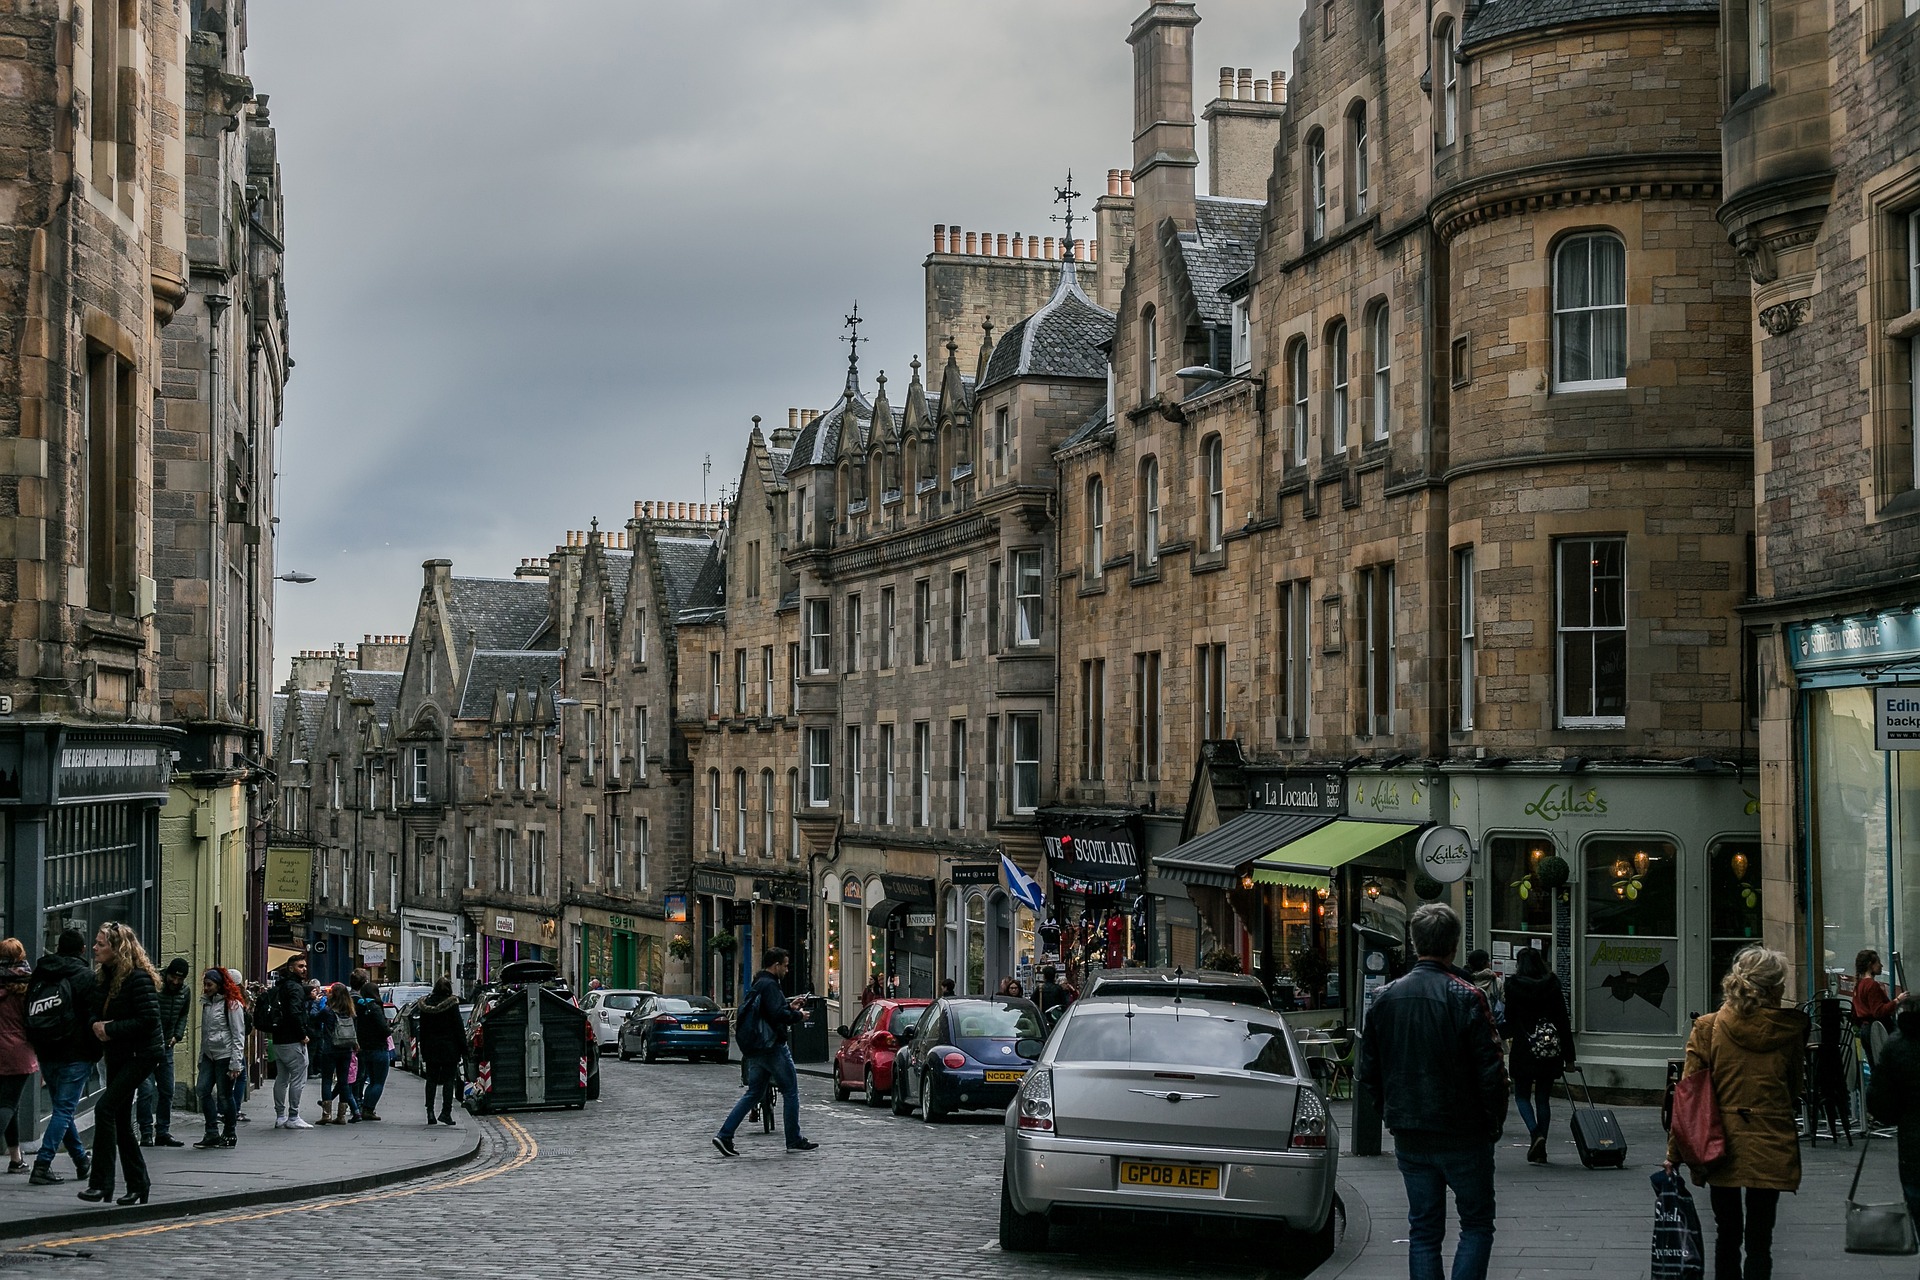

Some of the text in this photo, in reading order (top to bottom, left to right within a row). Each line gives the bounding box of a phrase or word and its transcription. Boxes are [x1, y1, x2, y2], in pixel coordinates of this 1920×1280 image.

[1811, 626, 1881, 653] SOUTHERN CROSS CAFE
[71, 749, 85, 768] BEST
[1265, 783, 1318, 807] La Locanda
[1044, 836, 1064, 860] WE
[277, 876, 299, 885] whisky
[697, 874, 735, 892] VIVA MEXICO
[908, 914, 935, 924] ANTIQUES
[1590, 941, 1662, 966] AVENGERS
[29, 991, 62, 1017] VANS
[1128, 1165, 1211, 1186] GP08 AEF
